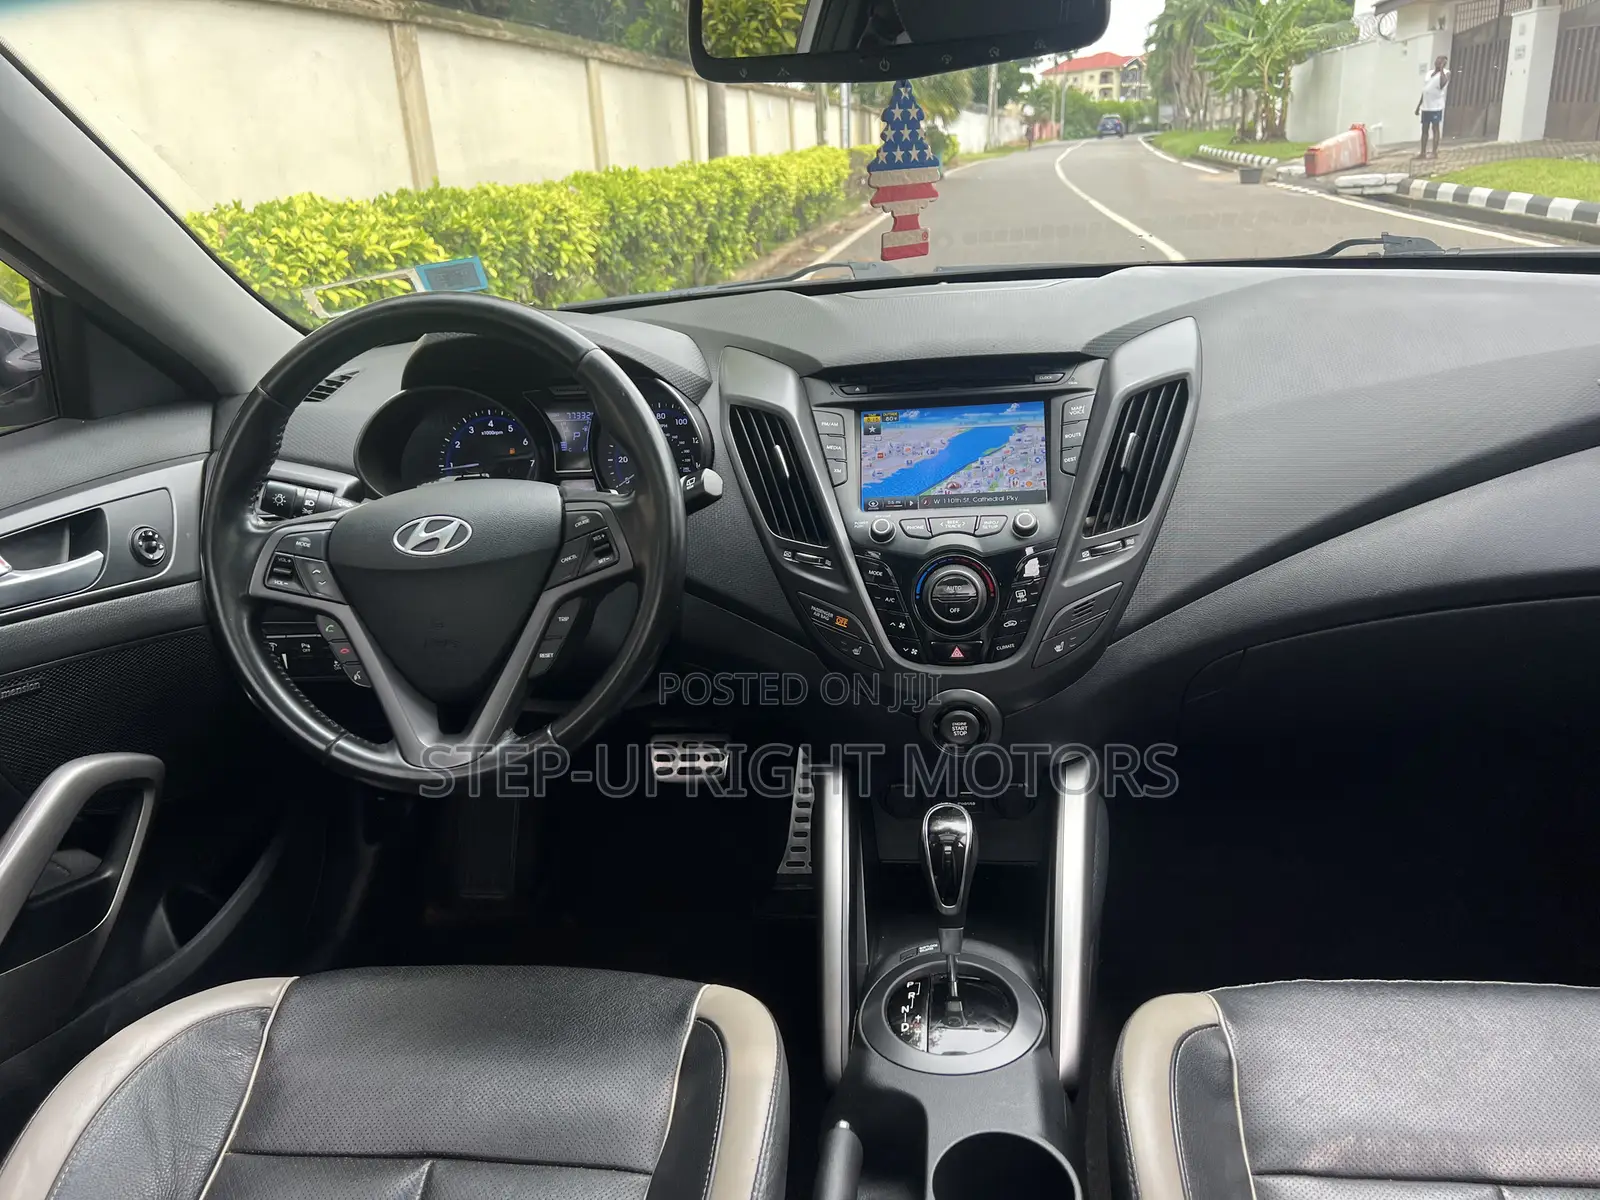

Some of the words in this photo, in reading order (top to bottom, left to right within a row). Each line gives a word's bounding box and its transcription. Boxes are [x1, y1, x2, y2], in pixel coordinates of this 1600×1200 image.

[656, 412, 666, 420] 80
[487, 420, 494, 428] 4
[675, 418, 688, 426] 100
[468, 426, 475, 434] 3
[507, 424, 514, 433] 5
[454, 440, 461, 449] 2
[522, 438, 529, 446] 6
[530, 459, 536, 468] 7
[618, 456, 629, 464] 20
[972, 494, 1005, 504] Cathedral
[1006, 494, 1019, 503] Pky
[574, 518, 590, 528] CRUISE
[560, 554, 578, 564] CANCEL
[868, 569, 883, 577] MODE
[810, 605, 834, 618] PASSENGER
[835, 615, 849, 628] OFF
[996, 643, 1015, 651] CLIMATE
[908, 991, 916, 1000] R
[901, 1005, 910, 1014] N
[901, 1023, 910, 1032] D
